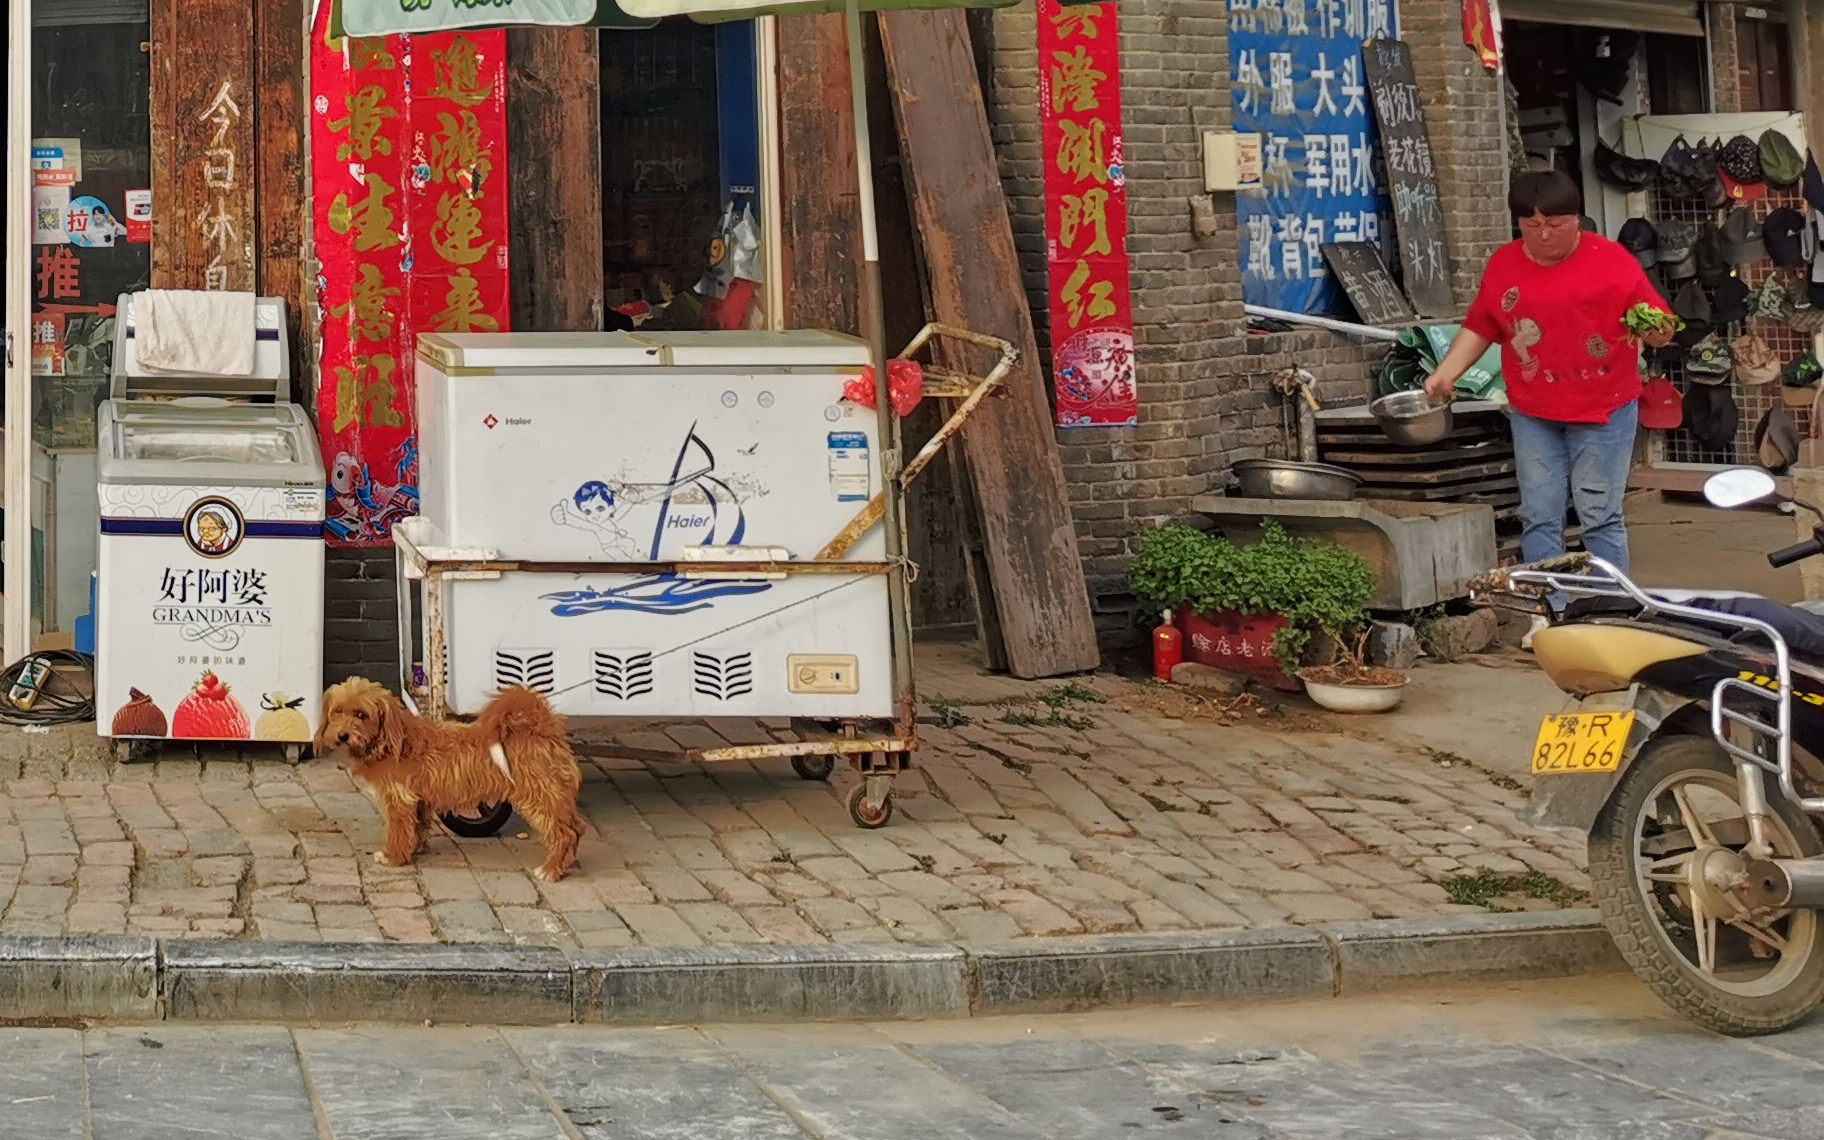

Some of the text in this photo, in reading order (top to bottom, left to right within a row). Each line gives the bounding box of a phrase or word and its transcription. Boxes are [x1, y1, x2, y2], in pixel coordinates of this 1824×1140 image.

[67, 210, 89, 233] 拉
[37, 245, 80, 299] 推
[33, 321, 56, 344] 推
[505, 417, 532, 426] Haier
[667, 513, 711, 530] Haier
[160, 567, 268, 606] 好阿婆
[152, 608, 272, 624] GRANDMA'S
[1535, 740, 1615, 770] 82L66
